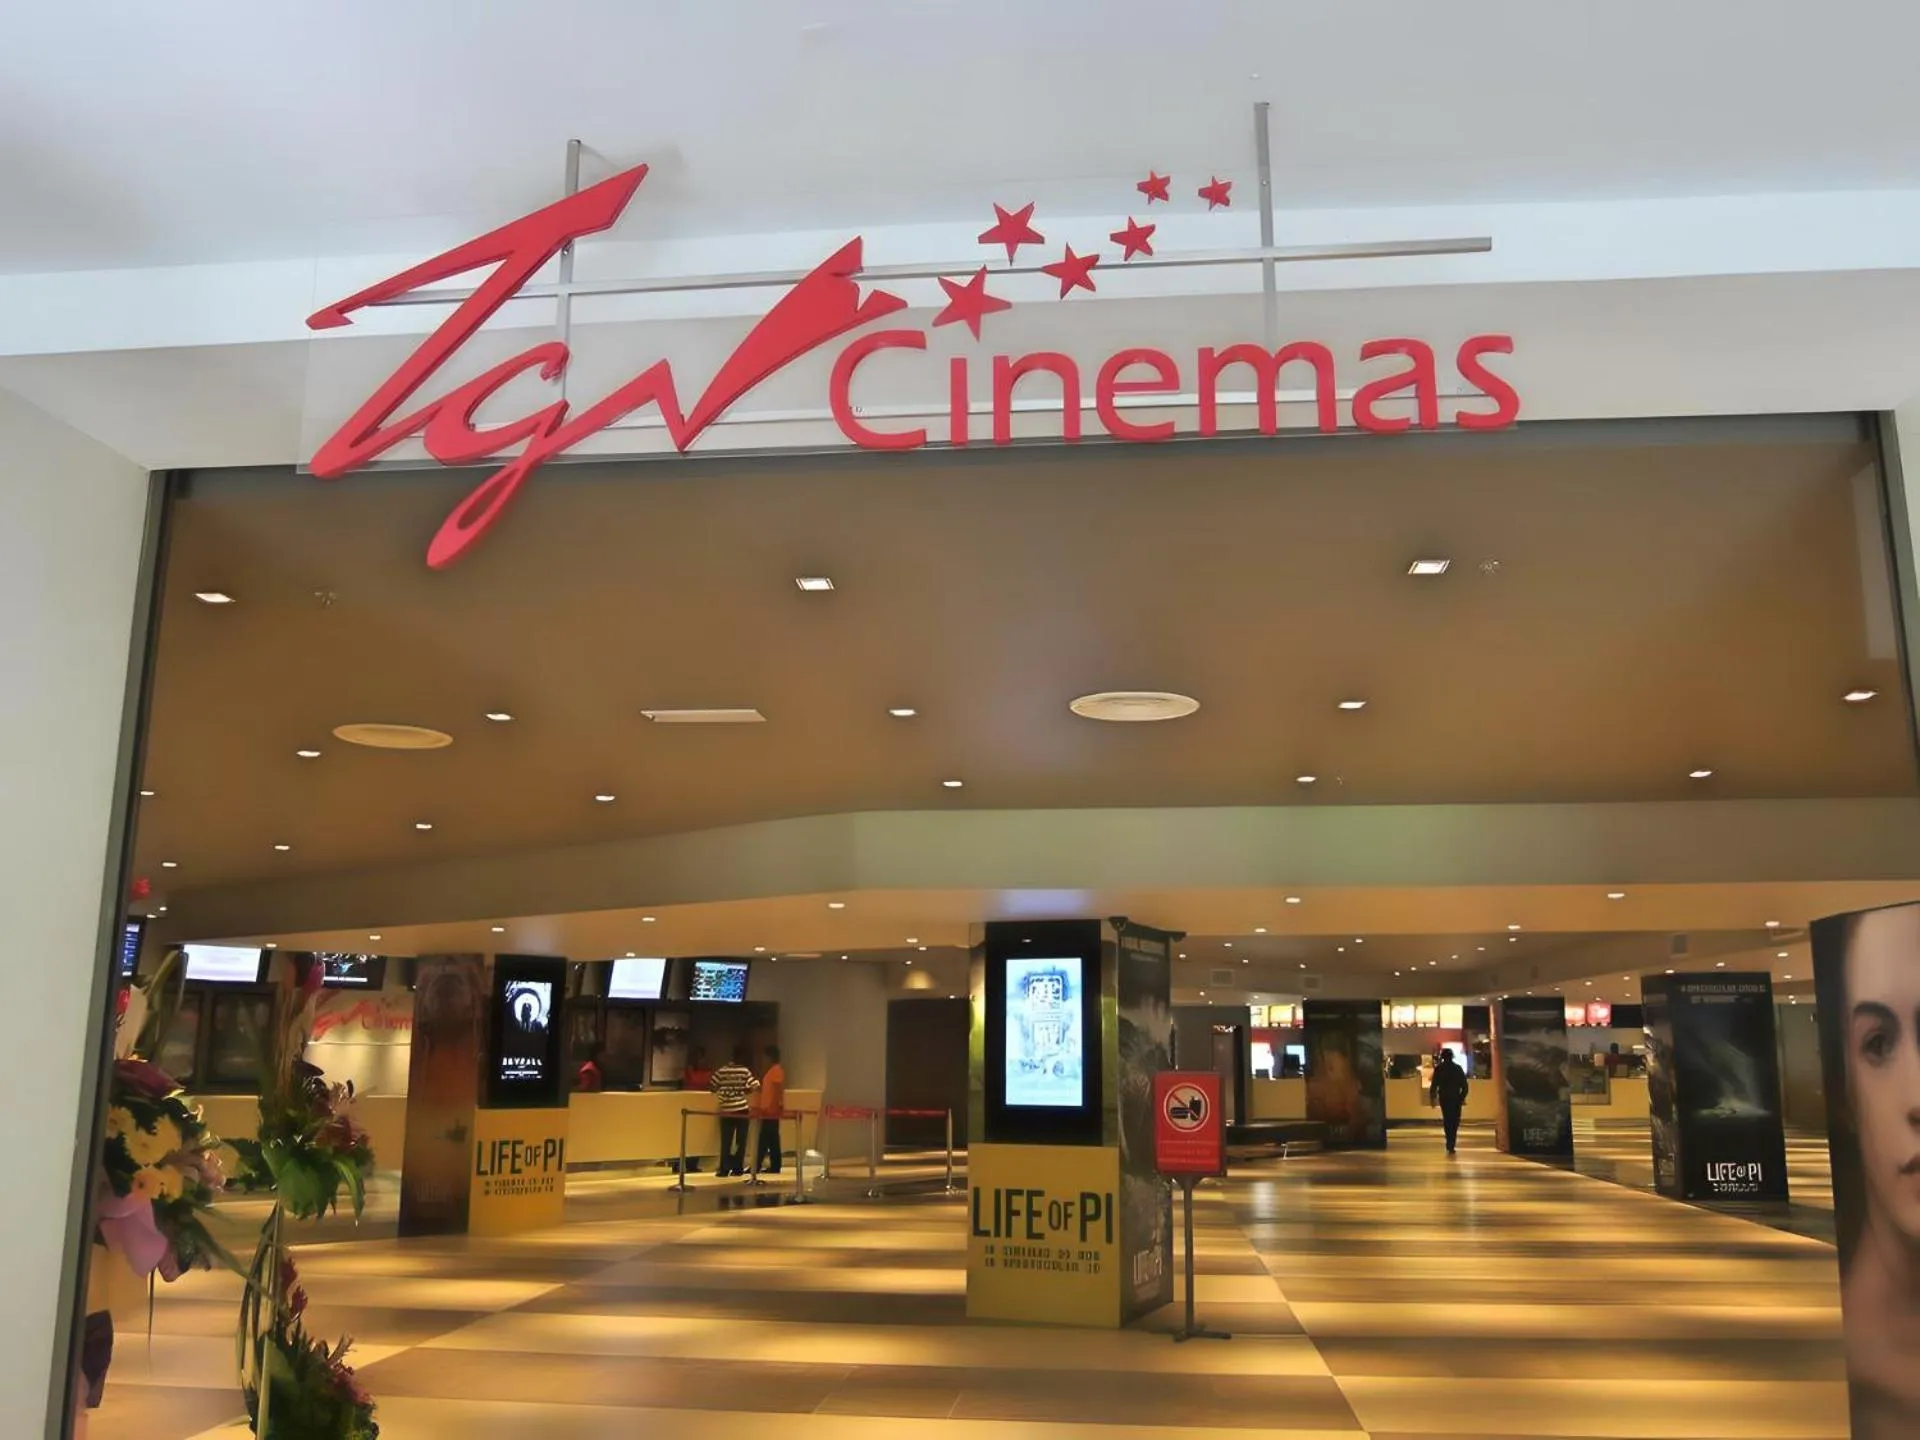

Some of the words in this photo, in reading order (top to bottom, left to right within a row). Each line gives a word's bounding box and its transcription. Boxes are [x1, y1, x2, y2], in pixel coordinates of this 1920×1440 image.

[829, 329, 1520, 450] Cinemas
[476, 1139, 524, 1176] LIFE
[525, 1145, 541, 1167] OF
[543, 1137, 564, 1173] PI
[1706, 1162, 1737, 1181] LIFE
[1748, 1162, 1762, 1182] PI
[972, 1186, 1045, 1240] LIFE
[1048, 1200, 1075, 1231] OF
[1080, 1191, 1113, 1244] PI
